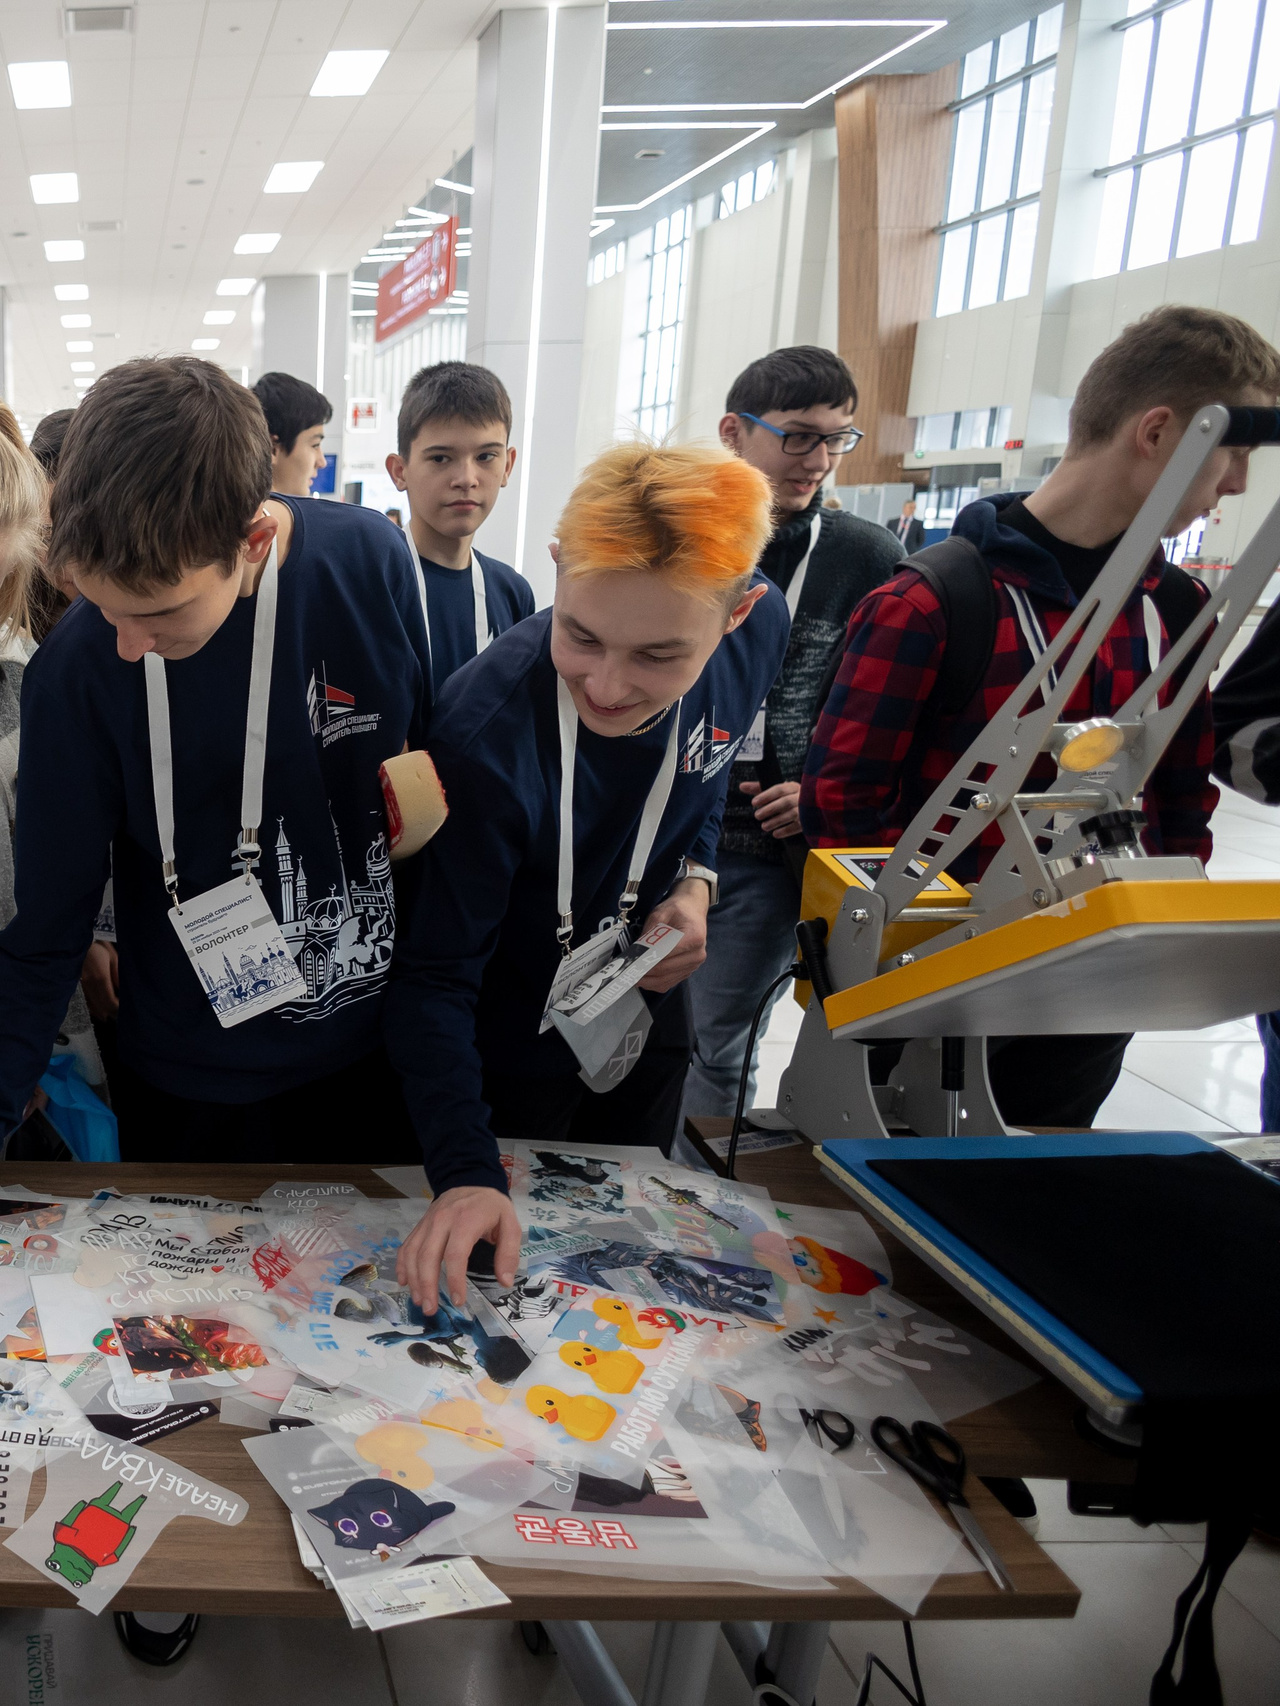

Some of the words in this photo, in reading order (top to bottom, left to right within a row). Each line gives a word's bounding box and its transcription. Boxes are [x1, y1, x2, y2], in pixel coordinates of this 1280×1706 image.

[321, 717, 346, 738] МОЛОДОЙ
[322, 726, 352, 748] СТРОИТЕЛЬ
[352, 722, 377, 734] БУДУЩЕГО
[184, 911, 215, 930] МОЛОДОЙ
[214, 894, 253, 916] СПЕЦИАЛИСТ
[194, 924, 249, 955] ВОЛОНТЕР
[151, 1249, 220, 1266] пожары
[154, 1237, 184, 1252] Мы
[205, 1244, 250, 1256] тобой
[518, 1232, 597, 1258] УСКОРЕНИ
[115, 1268, 172, 1286] КТО
[147, 1260, 205, 1274] дожди
[320, 1249, 365, 1286] LOVE
[110, 1286, 254, 1308] СЧАСТЛИВ
[551, 1279, 589, 1299] ТР
[308, 1322, 340, 1352] LIE
[58, 1351, 98, 1389] УСКОРЕНИЕ
[610, 1387, 672, 1459] РАБОТАЮ
[652, 1328, 705, 1391] СУТКАМИ
[24, 1433, 37, 1446] В
[65, 1430, 240, 1521] НЕАДЕКВААТ
[513, 1513, 639, 1550] 남동균
[43, 1633, 58, 1689] ПРИДАВАЙ
